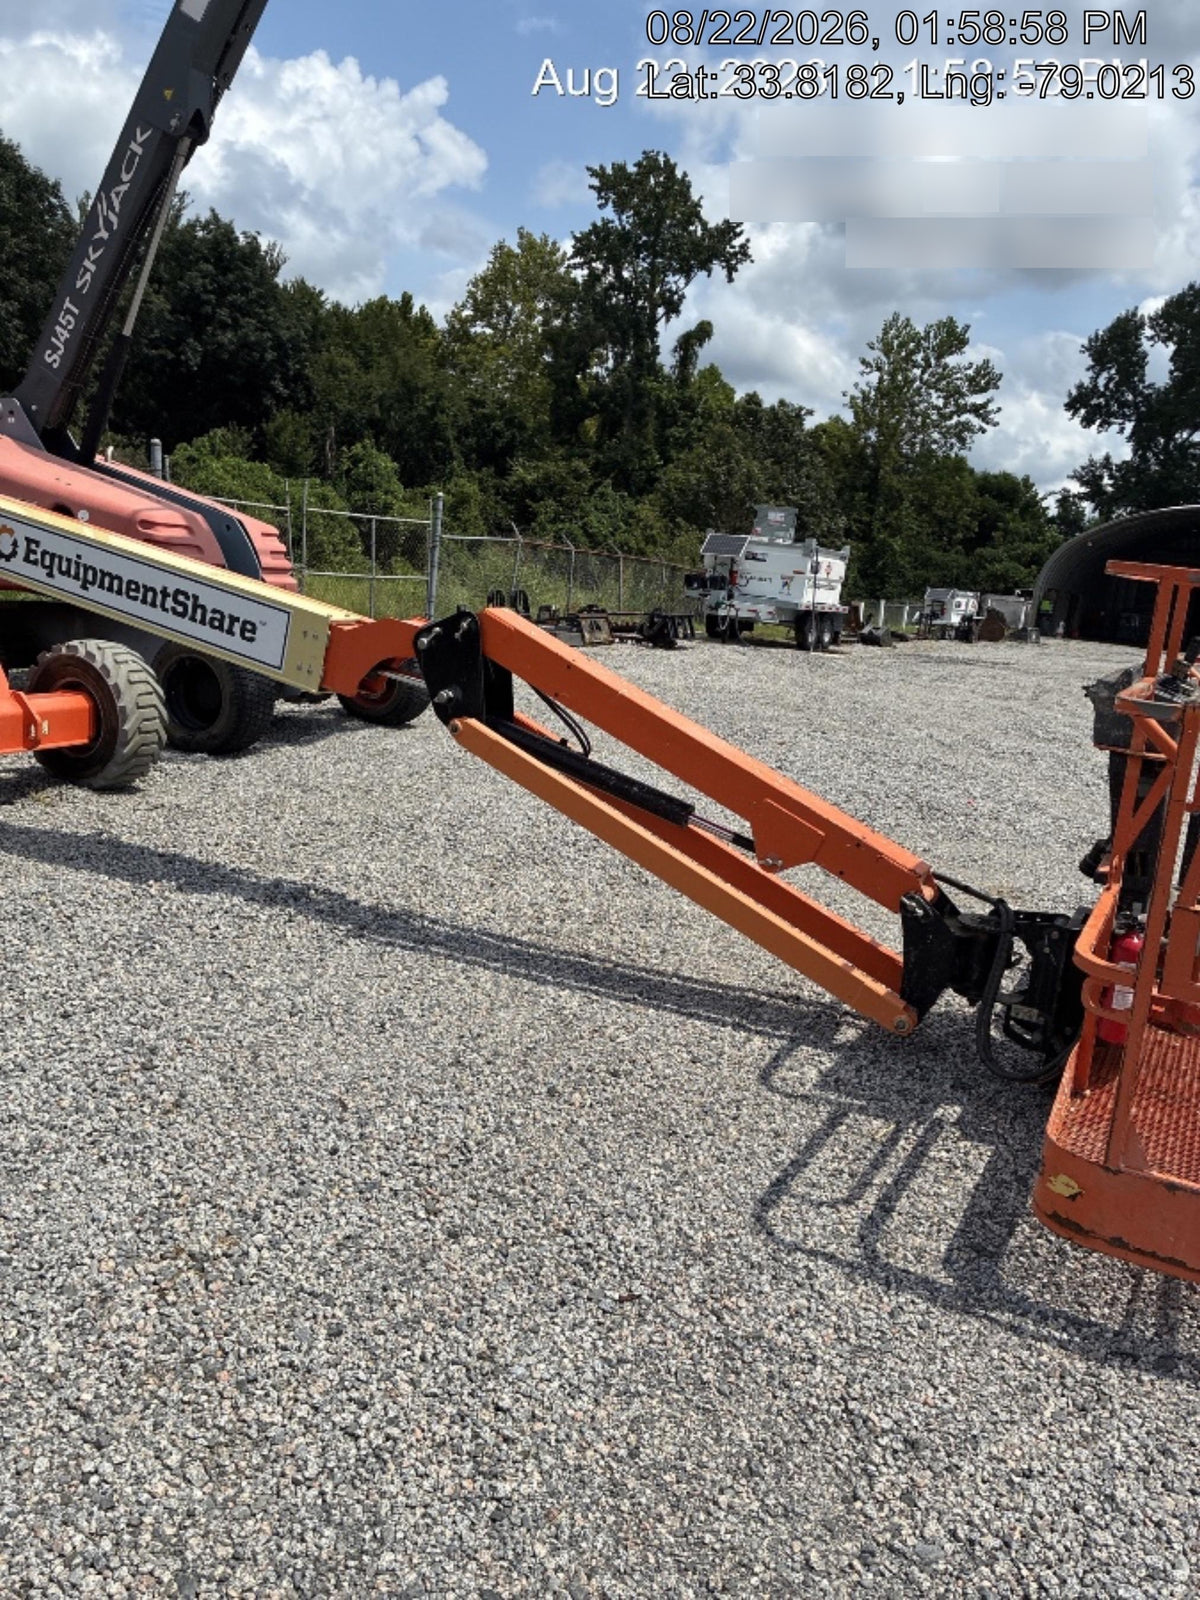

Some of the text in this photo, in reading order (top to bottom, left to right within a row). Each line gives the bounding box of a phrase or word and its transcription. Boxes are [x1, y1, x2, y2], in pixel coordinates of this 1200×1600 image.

[44, 125, 154, 370] SJ45T SKYJACK
[22, 535, 258, 644] EquipmentShare
